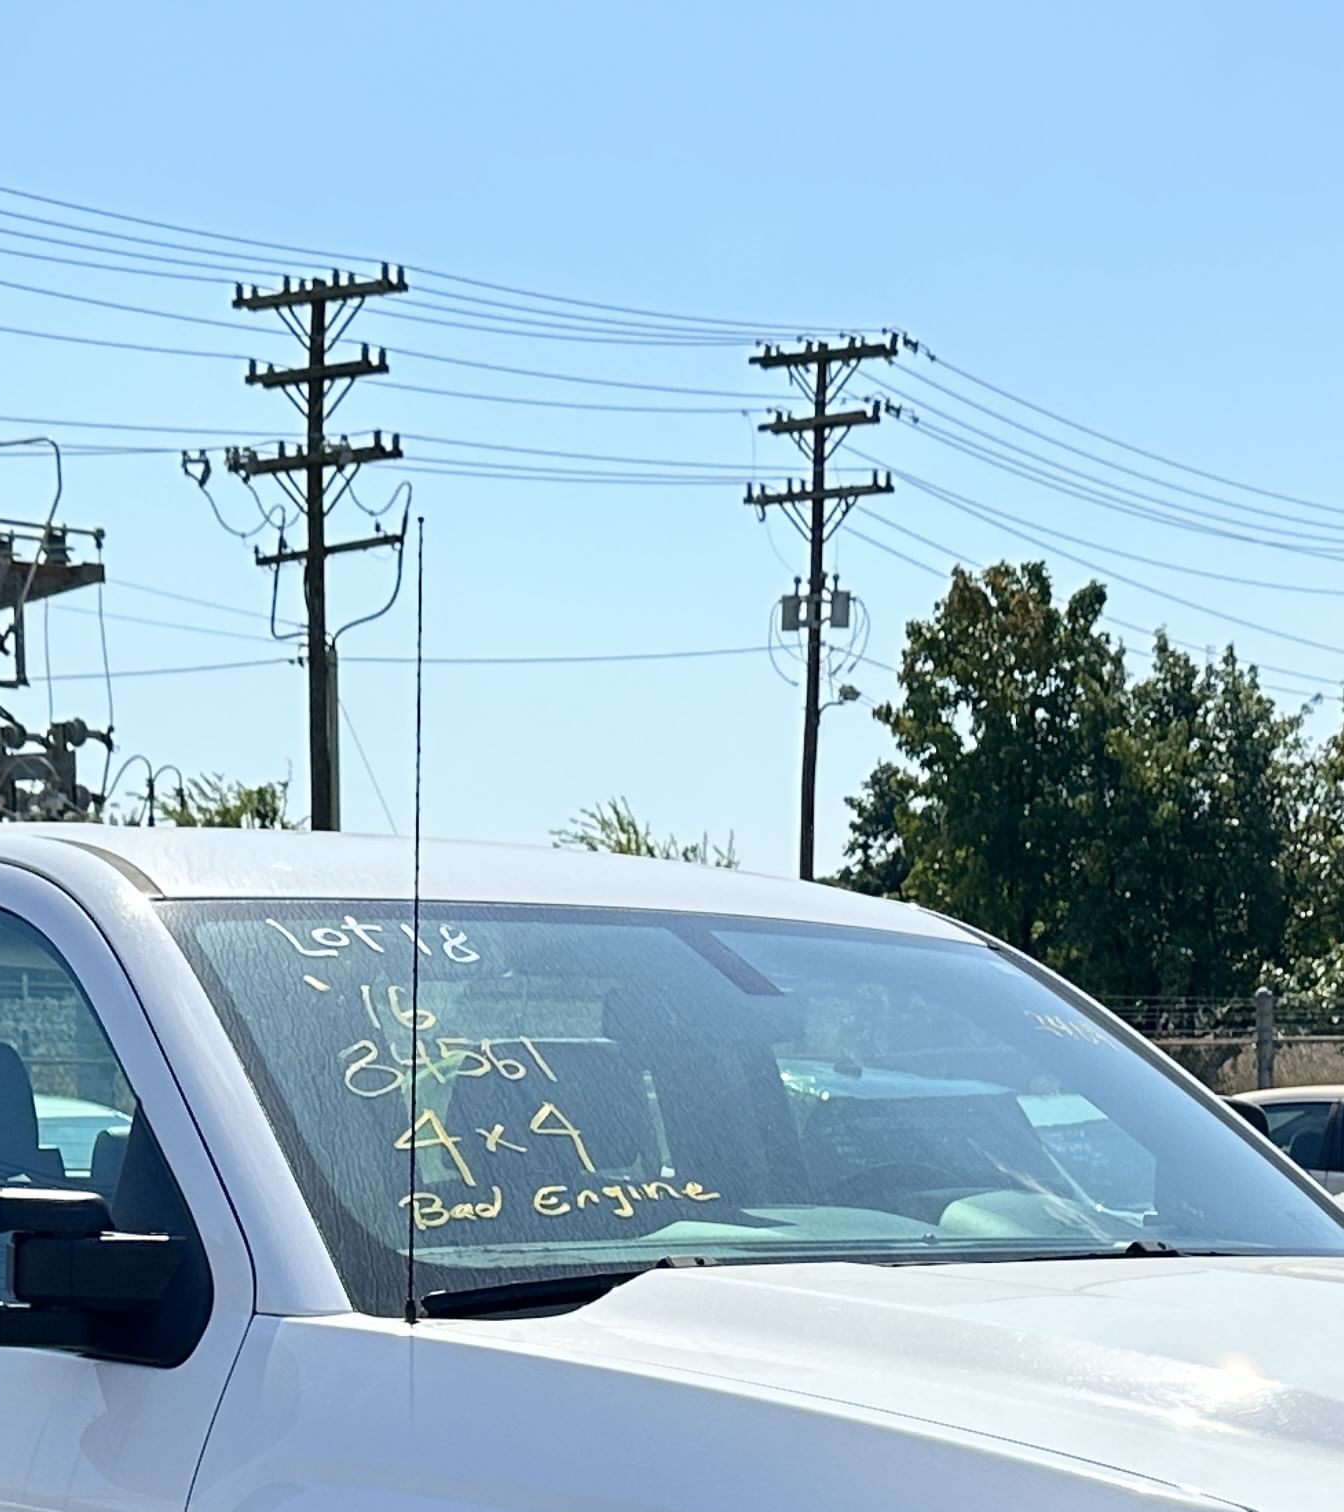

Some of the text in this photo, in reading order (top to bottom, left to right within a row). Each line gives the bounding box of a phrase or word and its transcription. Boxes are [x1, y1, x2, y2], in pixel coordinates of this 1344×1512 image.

[264, 915, 481, 963] Lot 18
[338, 1036, 557, 1097] 84561
[398, 1181, 721, 1230] Bad Engine
